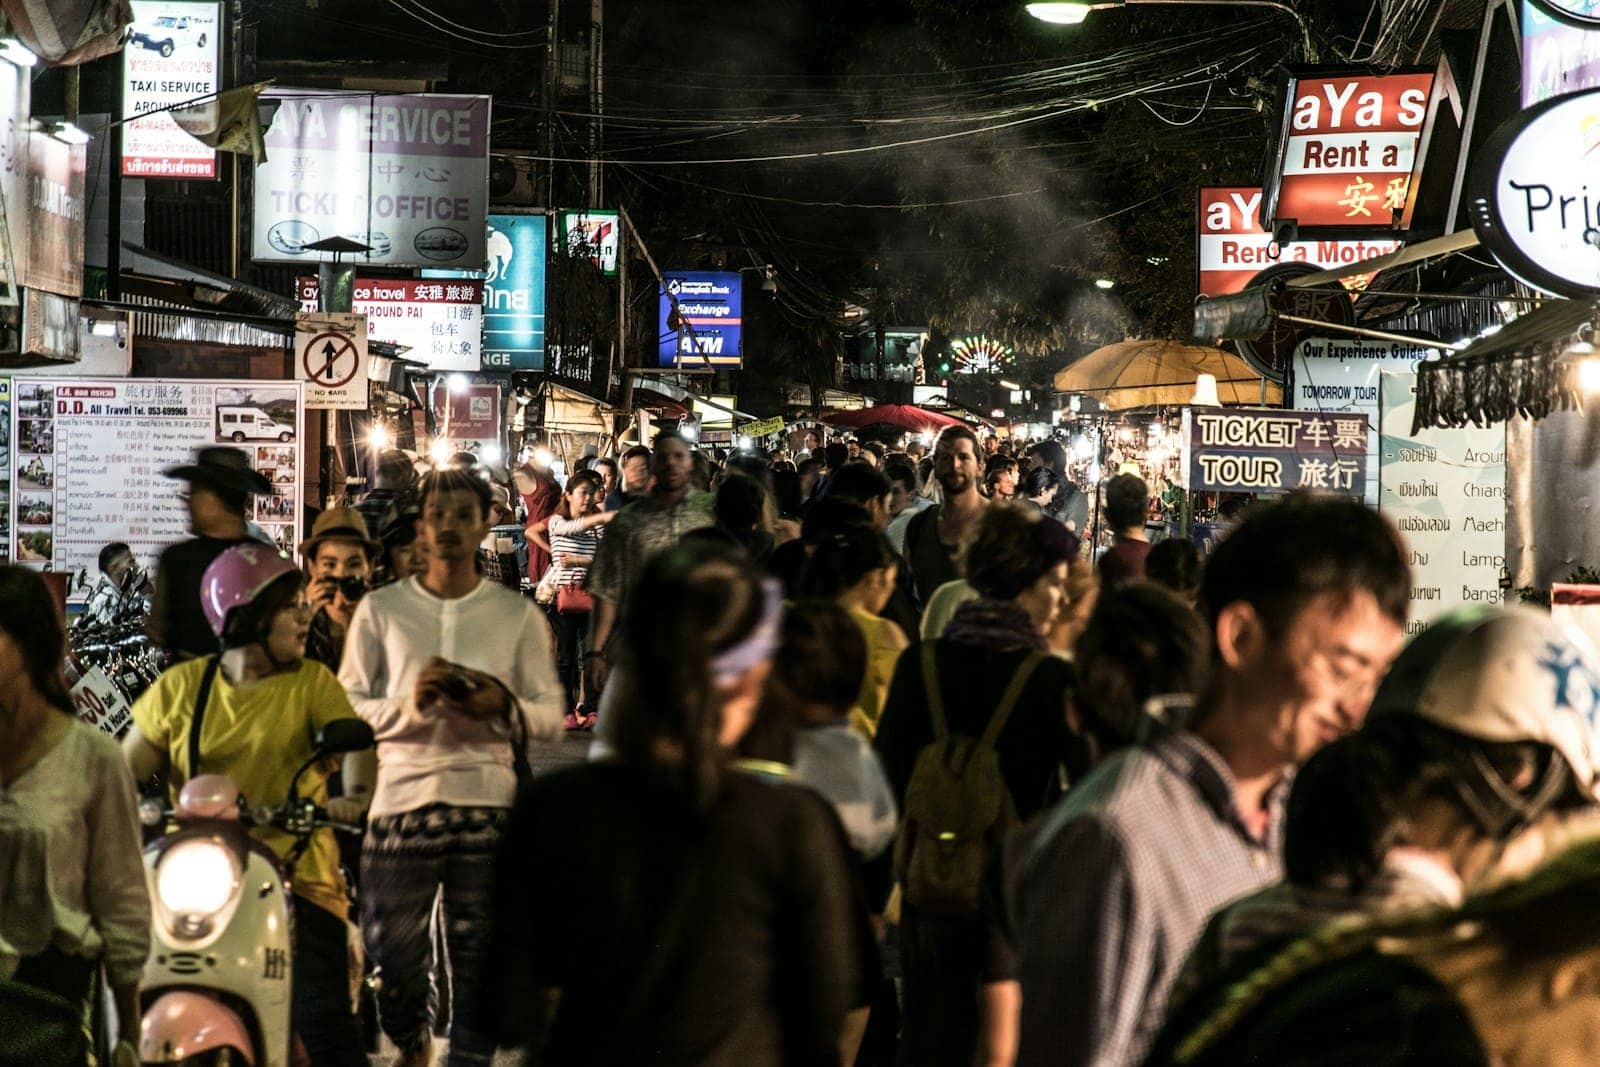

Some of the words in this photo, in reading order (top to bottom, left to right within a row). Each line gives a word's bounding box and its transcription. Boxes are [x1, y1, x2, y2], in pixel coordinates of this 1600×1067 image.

[130, 80, 157, 92] TAXI
[161, 81, 211, 93] SERVICE
[134, 101, 180, 112] AROU
[1293, 82, 1384, 131] aYa
[340, 103, 472, 146] ERVICE
[1303, 139, 1369, 169] Rent
[1381, 145, 1399, 167] a
[271, 190, 365, 217] TICK
[375, 195, 470, 221] OFFICE
[1508, 179, 1600, 246] Pri
[1222, 241, 1280, 264] Rent
[1293, 244, 1308, 262] a
[1317, 241, 1401, 262] Motor
[303, 287, 319, 300] ay
[372, 287, 406, 300] travel
[414, 285, 444, 301] 安雅
[446, 285, 475, 301] 旅游
[363, 306, 404, 318] AROUND
[407, 307, 423, 319] PAI
[678, 304, 731, 317] Exchange
[681, 336, 724, 353] ATM
[1303, 342, 1324, 358] Our
[1327, 343, 1387, 362] Experience
[125, 384, 183, 399] 旅行服务
[1302, 385, 1352, 399] TOMORROW
[1354, 386, 1377, 400] TOUR
[57, 400, 89, 416] D.D.
[90, 404, 102, 415] All
[106, 404, 132, 416] Travel
[134, 406, 146, 416] Tel.
[1197, 414, 1302, 448] TICKET
[1302, 417, 1367, 449] 车票
[1198, 455, 1283, 487] TOUR
[1297, 458, 1360, 489] 旅行
[1462, 550, 1505, 569] Lamp
